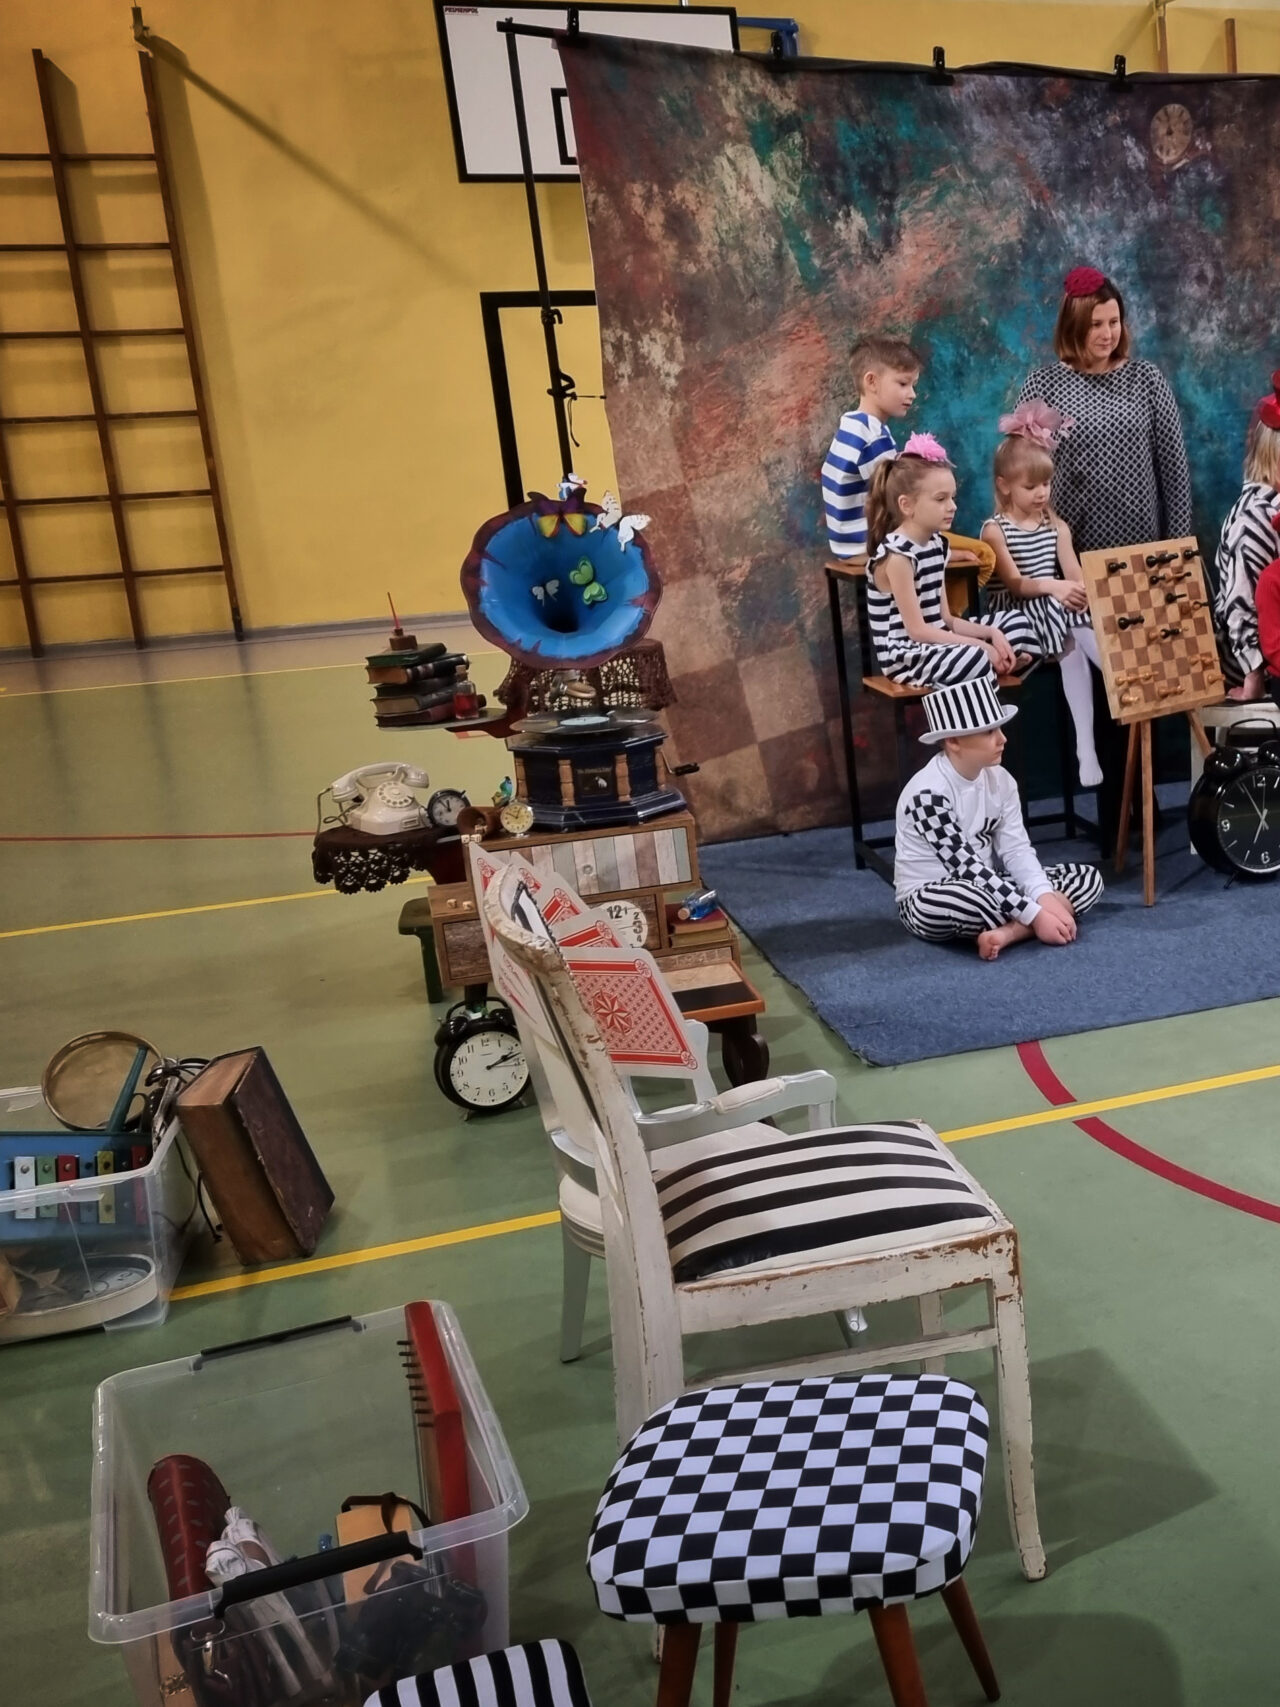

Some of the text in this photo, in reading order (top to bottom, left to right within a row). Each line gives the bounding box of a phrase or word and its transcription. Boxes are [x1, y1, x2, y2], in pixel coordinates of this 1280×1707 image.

[1252, 774, 1266, 788] 12
[1221, 819, 1231, 832] 9
[1261, 851, 1270, 864] 6
[606, 905, 622, 919] 12
[624, 906, 628, 915] 1
[633, 911, 640, 920] 2
[632, 920, 643, 934] 3
[481, 1038, 490, 1047] 12
[467, 1044, 475, 1054] 11
[458, 1056, 468, 1065] 10
[456, 1069, 464, 1078] 9
[475, 1086, 481, 1096] 7
[502, 1082, 509, 1091] 5
[488, 1088, 496, 1097] 6
